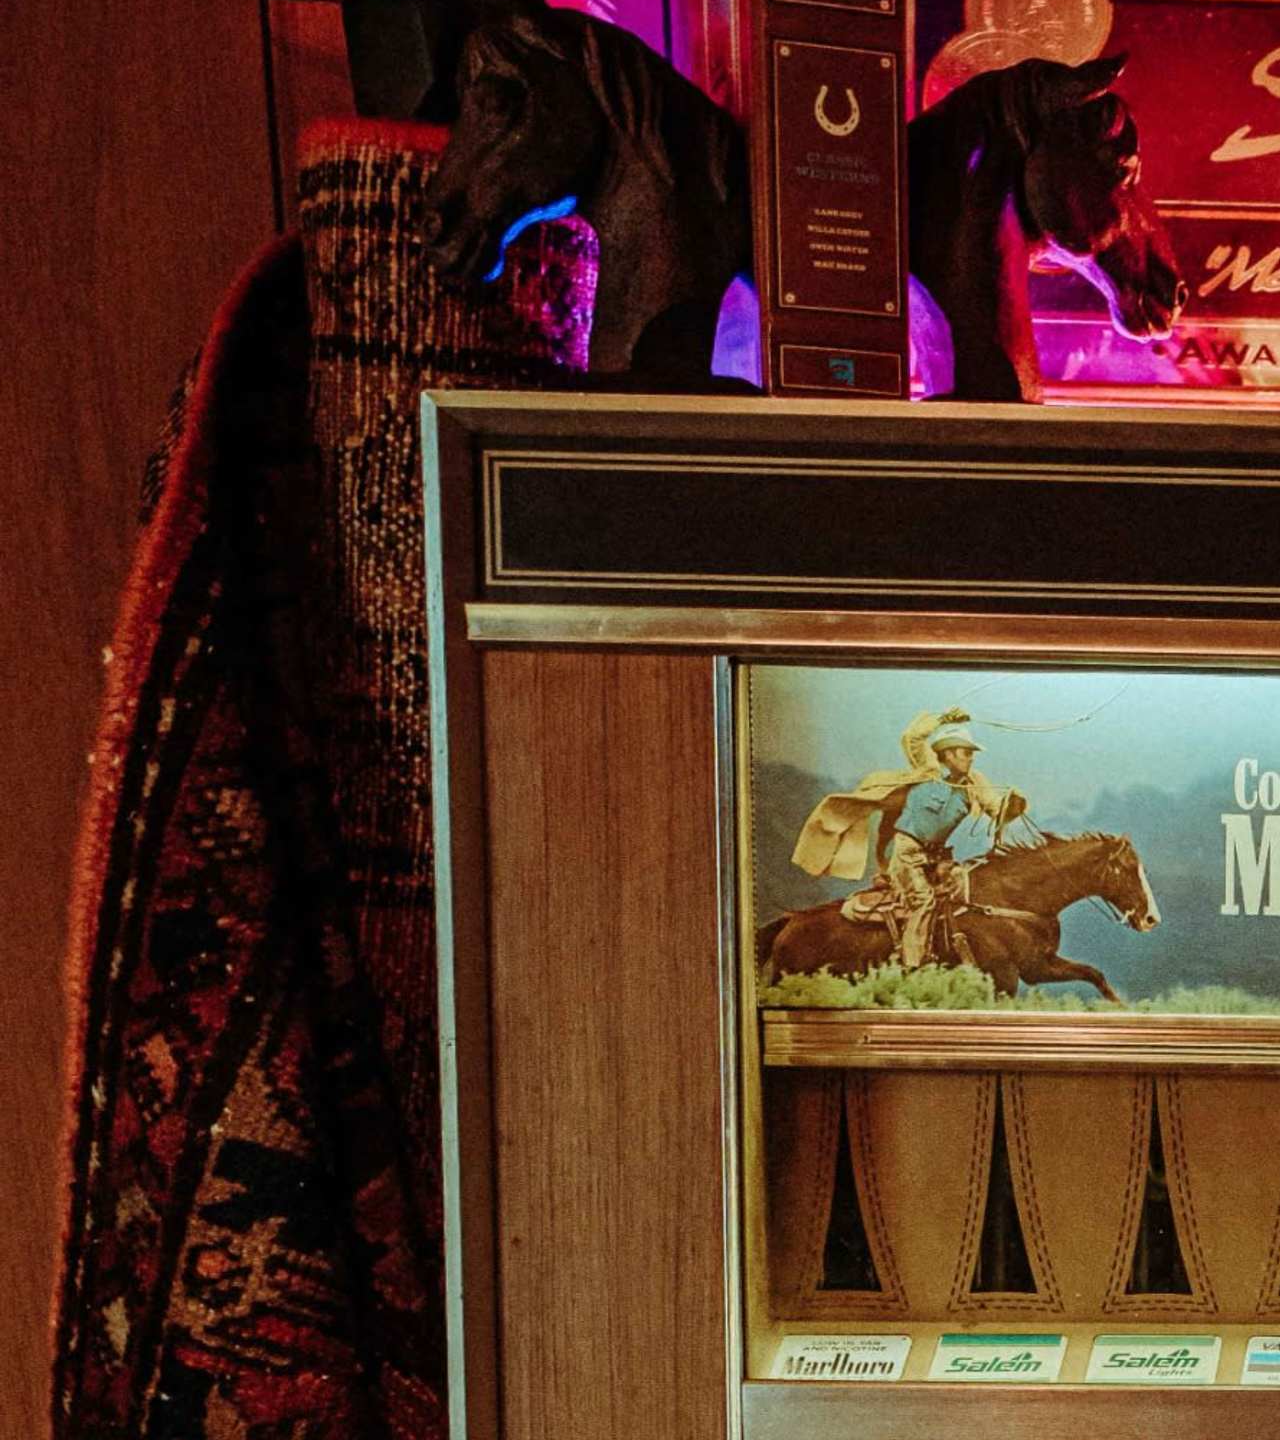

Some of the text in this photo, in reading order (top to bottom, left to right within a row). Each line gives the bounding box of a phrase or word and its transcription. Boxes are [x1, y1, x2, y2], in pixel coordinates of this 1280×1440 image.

[784, 1353, 895, 1375] Marlboro
[944, 1354, 1042, 1373] Salem
[1103, 1351, 1200, 1369] Salem
